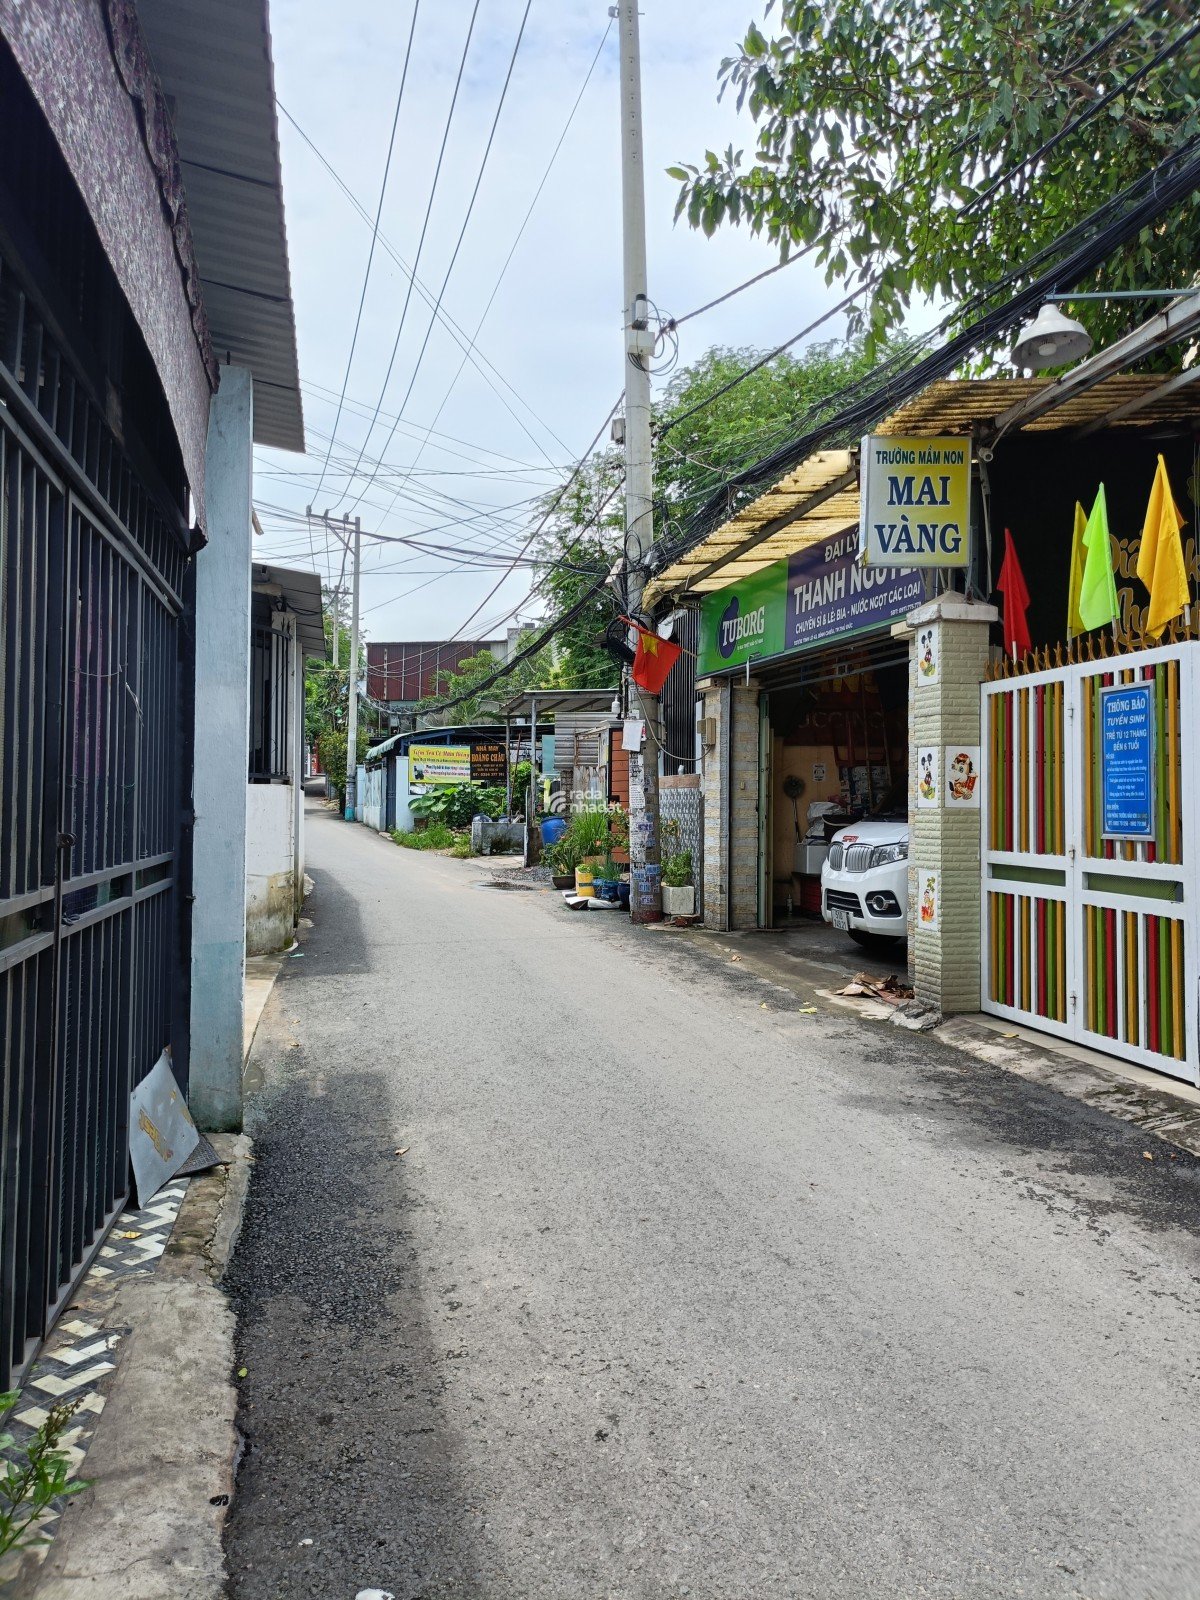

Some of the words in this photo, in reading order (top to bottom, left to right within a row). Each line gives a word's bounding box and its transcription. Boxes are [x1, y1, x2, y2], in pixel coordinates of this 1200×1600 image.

[876, 446, 915, 465] TRƯỜNG
[918, 445, 941, 464] MẦM
[943, 450, 964, 465] NON
[887, 476, 951, 506] MAI
[874, 513, 962, 554] VÀNG
[825, 537, 844, 563] ĐẠI
[794, 571, 846, 615] THANH
[795, 616, 816, 635] CHUYÊN
[822, 614, 827, 625] &
[836, 607, 847, 621] BIA
[851, 597, 869, 617] NƯỚC
[869, 592, 887, 610] NGỌT
[888, 586, 903, 603] CÁC
[903, 581, 921, 598] LOẠI
[722, 604, 765, 647] TUBORG
[1107, 699, 1130, 713] THÔNG
[1131, 696, 1146, 710] BÁO
[1107, 713, 1129, 726] TUYỂN
[1129, 714, 1146, 724] SINH
[1106, 730, 1116, 740] TRẺ
[1116, 730, 1123, 739] TỪ
[1124, 731, 1129, 739] 12
[1130, 728, 1147, 738] THÁNG
[1113, 741, 1123, 751] ĐẾN
[1128, 738, 1140, 750] TUỔI
